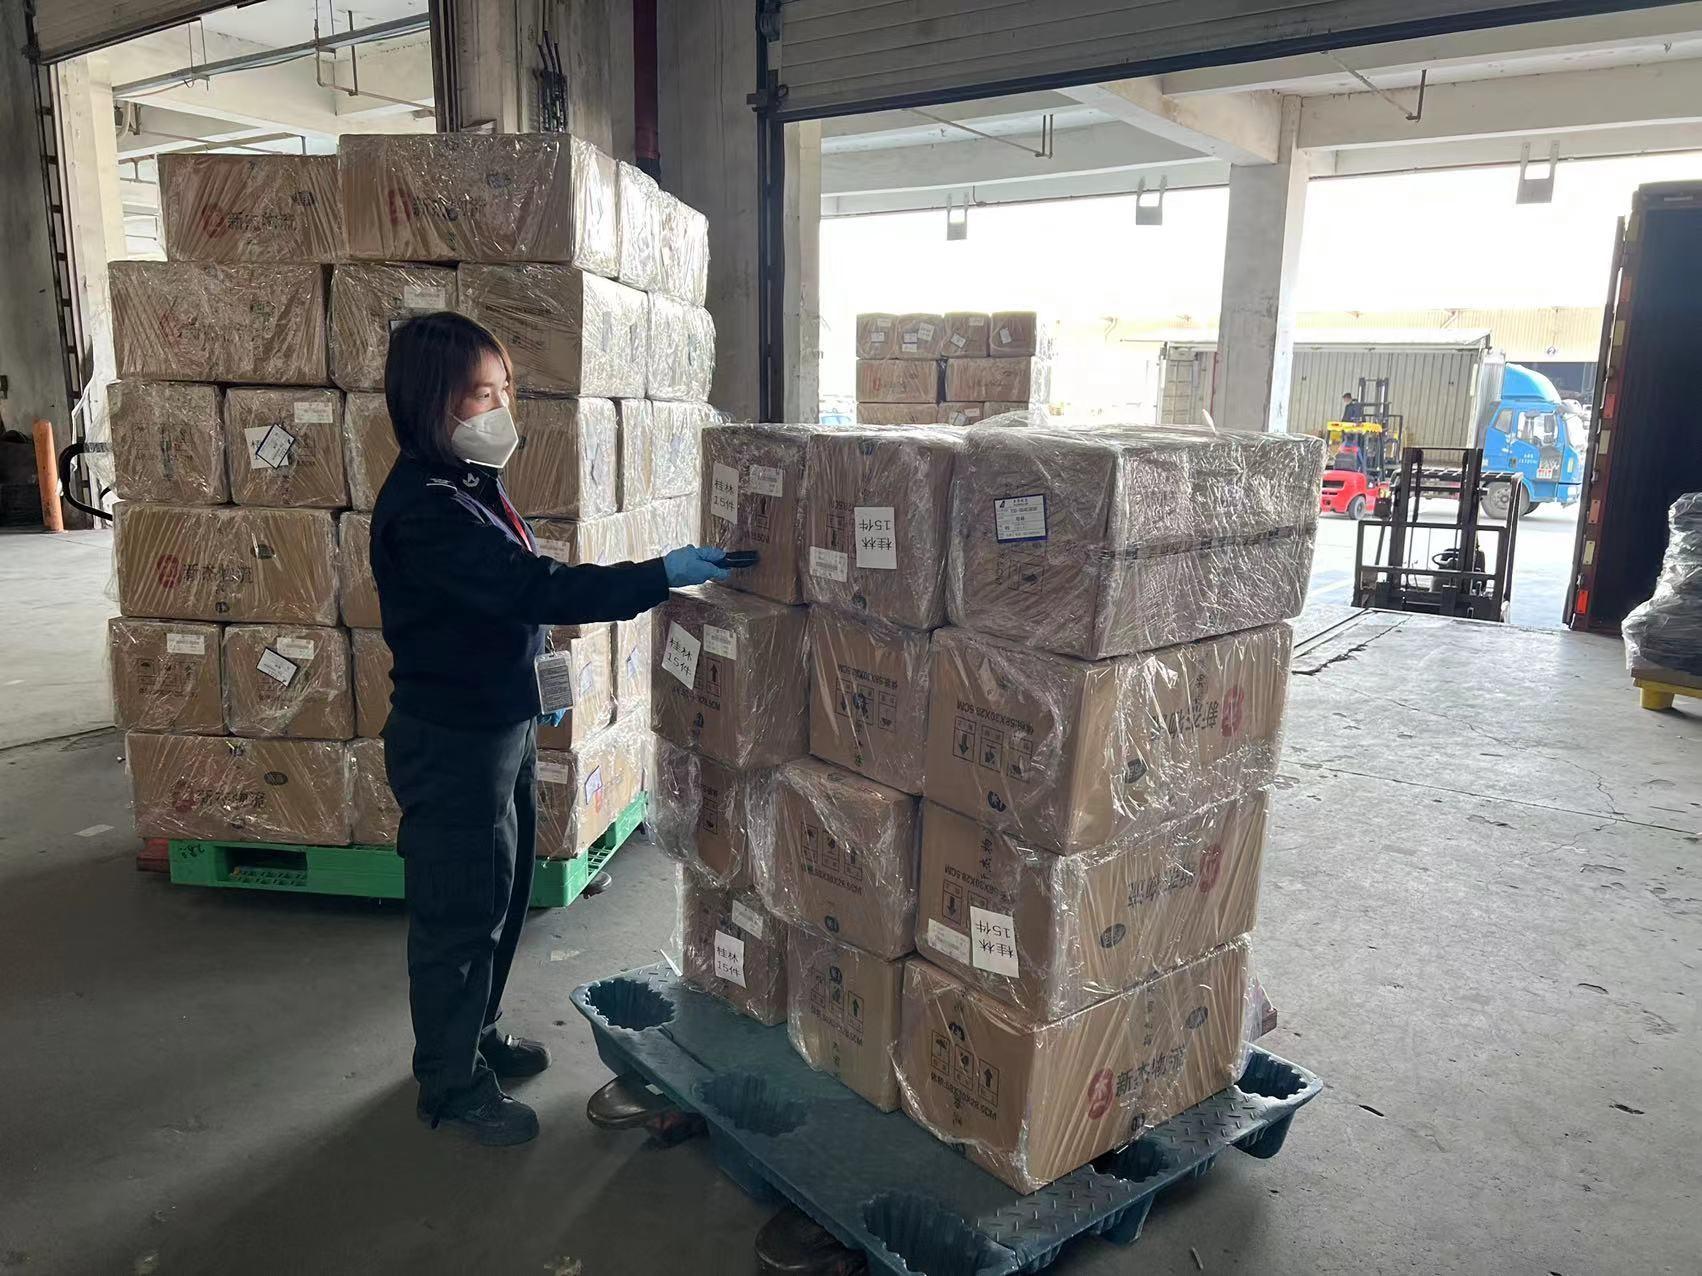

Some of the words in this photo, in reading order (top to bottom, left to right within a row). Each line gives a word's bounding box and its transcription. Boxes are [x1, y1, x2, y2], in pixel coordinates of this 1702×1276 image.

[714, 479, 734, 495] 桂林
[713, 495, 735, 512] 15件
[859, 518, 891, 531] 15件
[861, 536, 892, 551] 桂林
[669, 637, 692, 661] 桂林
[666, 653, 692, 676] 15件
[975, 919, 1011, 939] 15件
[716, 945, 739, 963] 桂林
[978, 938, 1014, 959] 桂林
[717, 961, 741, 977] 15件
